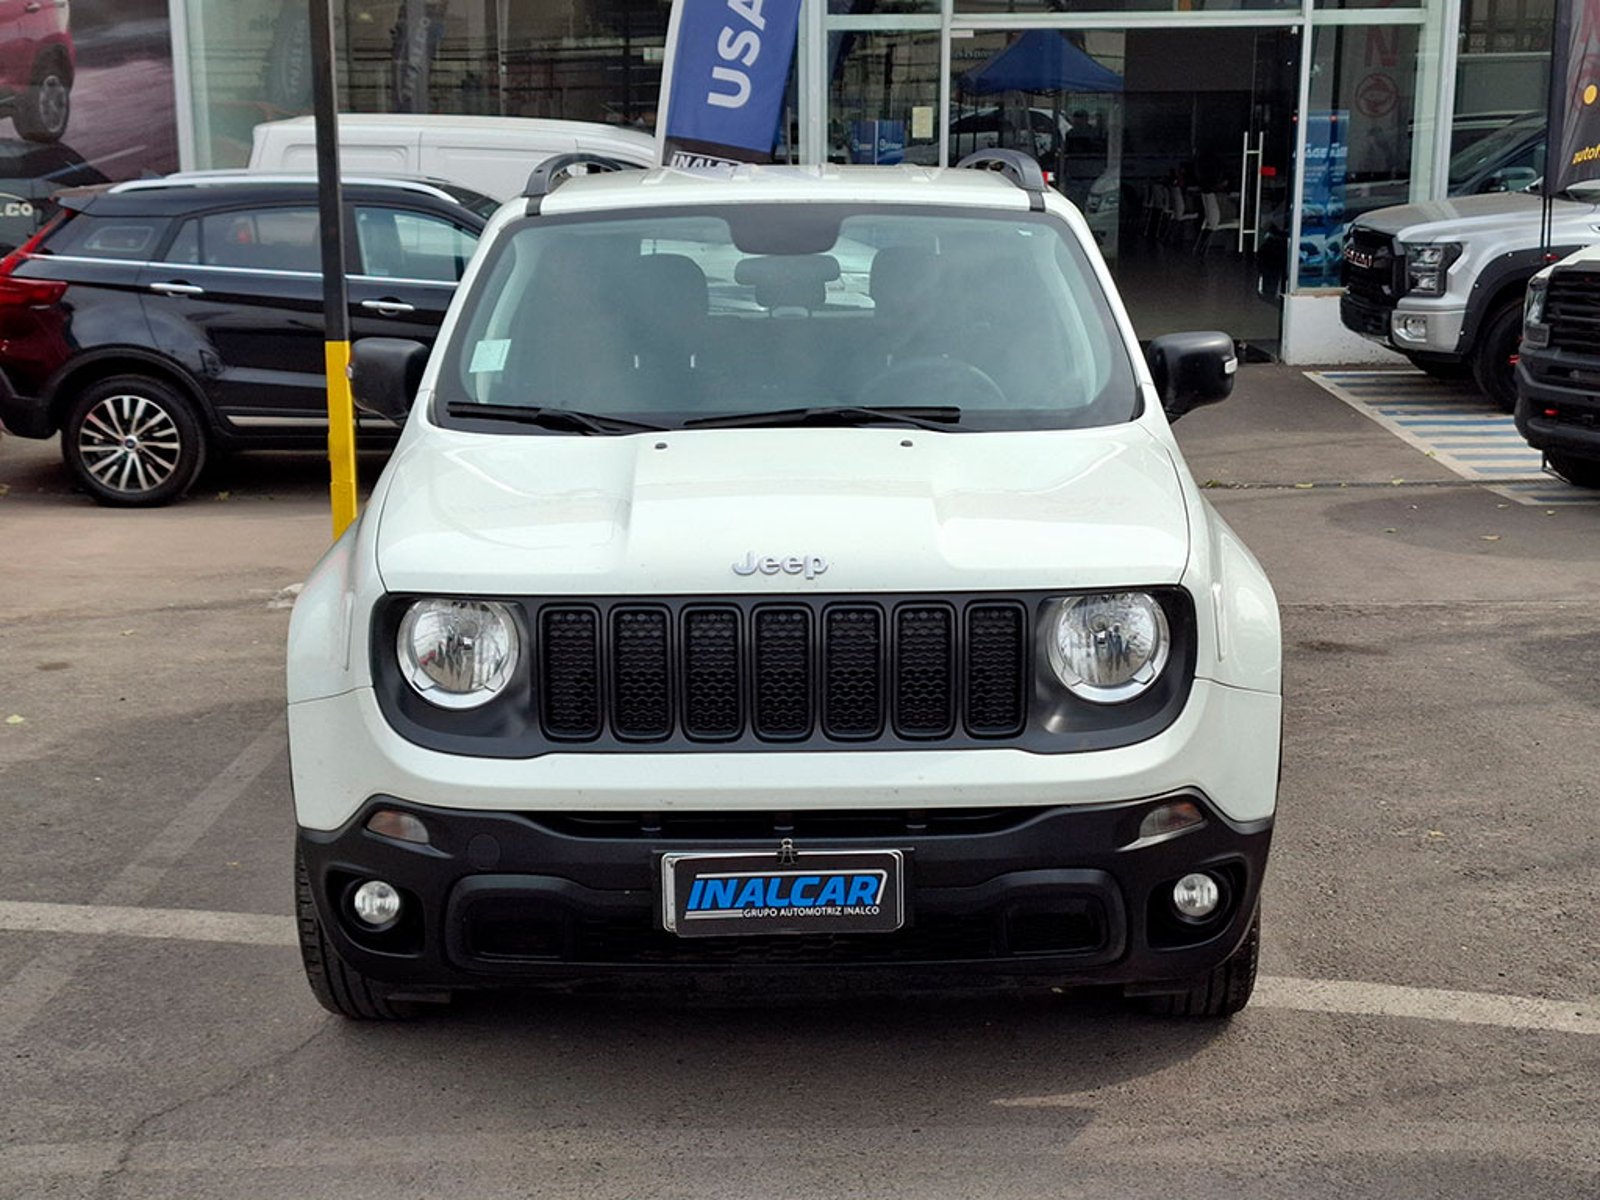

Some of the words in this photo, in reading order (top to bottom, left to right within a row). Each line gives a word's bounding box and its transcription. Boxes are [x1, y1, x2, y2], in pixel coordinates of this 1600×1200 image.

[0, 202, 33, 217] CO
[732, 551, 828, 580] Jeep
[687, 875, 879, 910] INALCAR
[743, 908, 777, 918] GRUPO
[780, 907, 842, 917] AUTOMOTRIZ
[843, 906, 880, 916] INALCO
